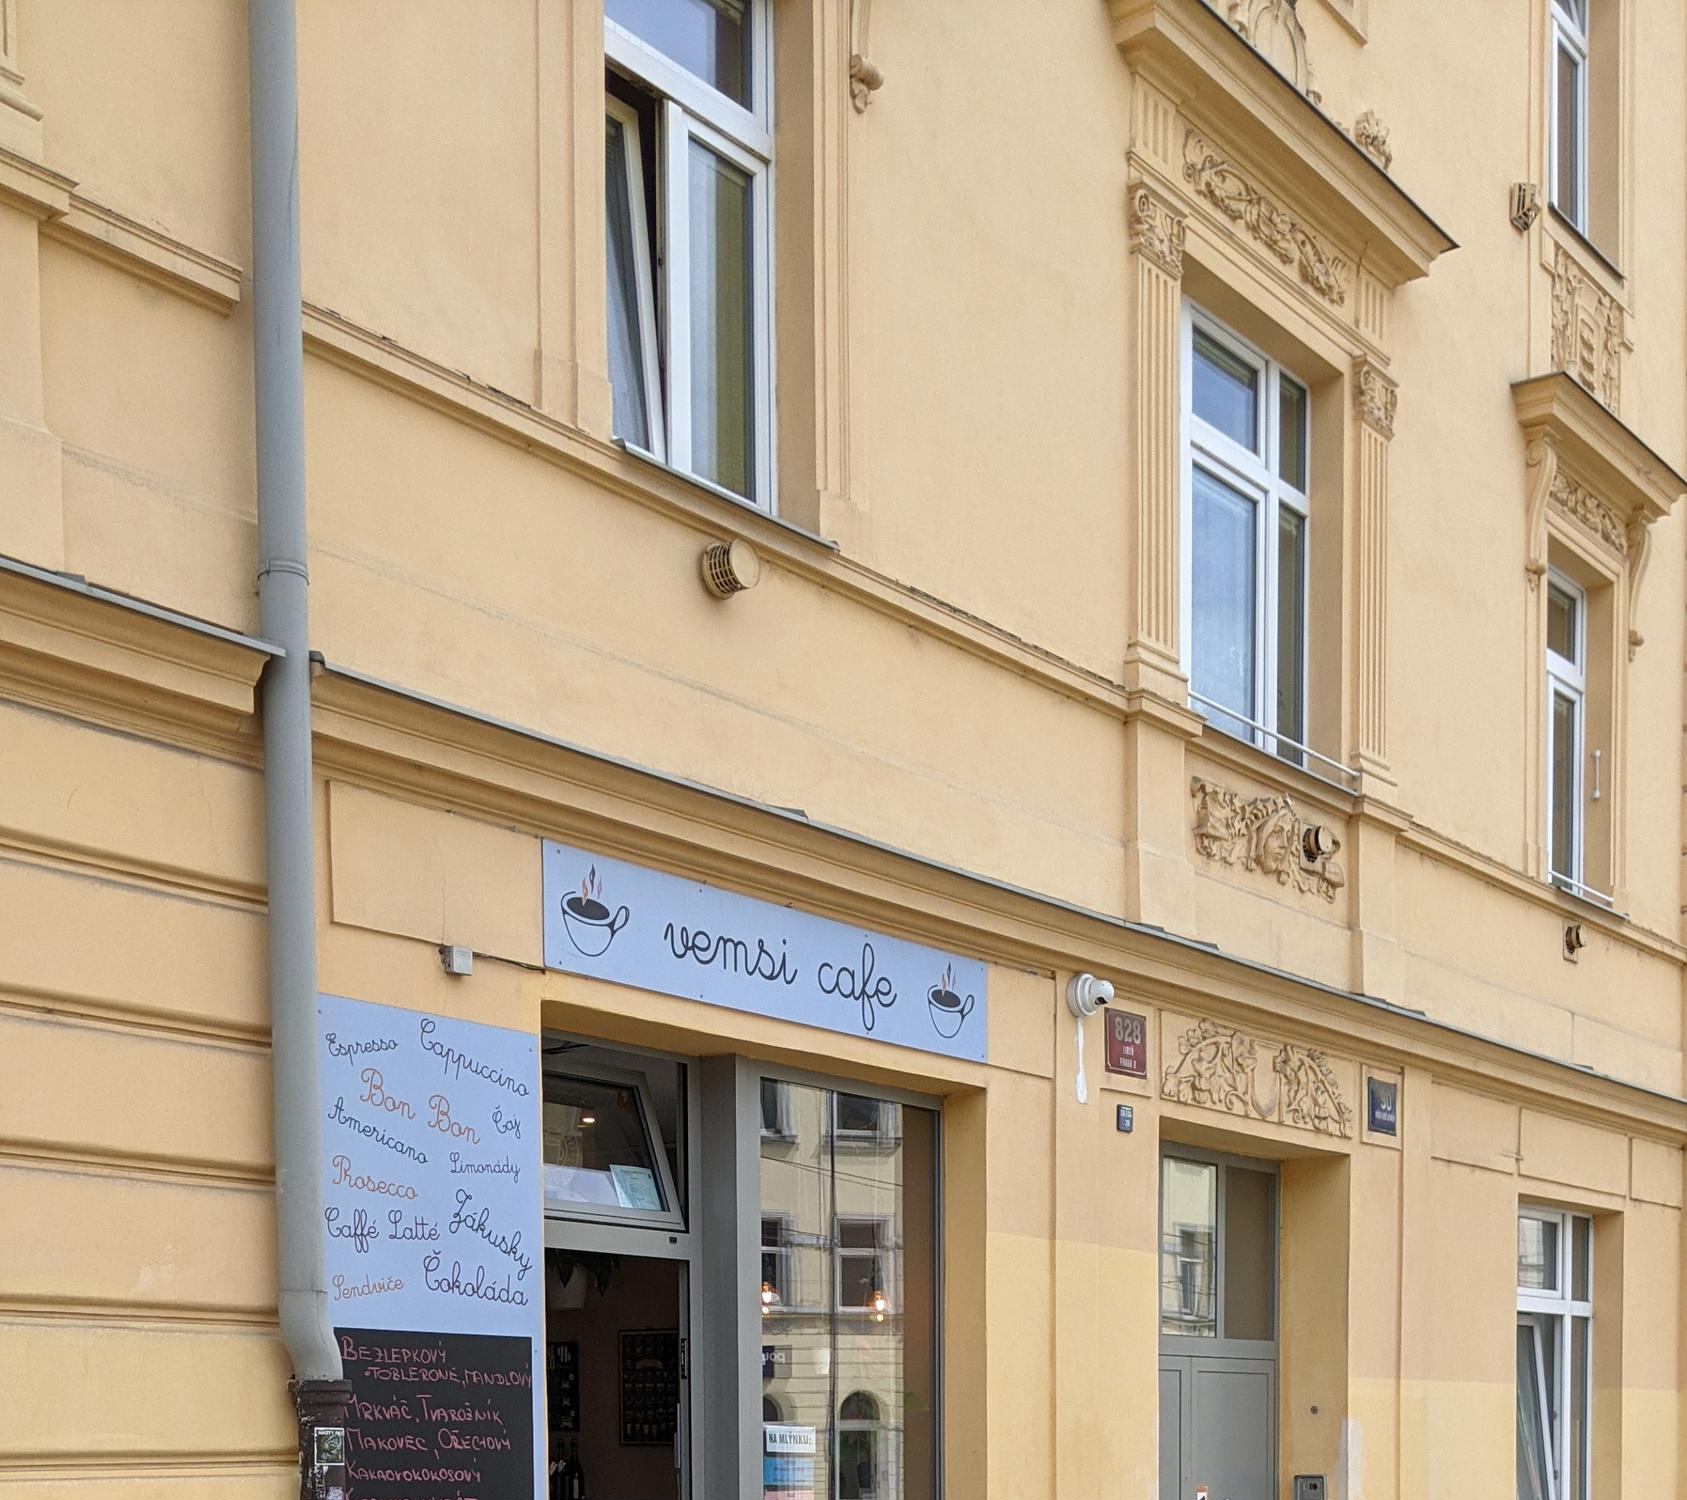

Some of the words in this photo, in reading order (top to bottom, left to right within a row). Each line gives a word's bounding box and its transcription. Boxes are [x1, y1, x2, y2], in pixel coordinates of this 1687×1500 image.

[664, 922, 798, 985] vemsi
[818, 942, 898, 1032] cafe
[326, 1033, 398, 1066] Espresso
[1116, 1016, 1140, 1044] 828
[420, 1018, 530, 1096] Cappuccino
[360, 1068, 415, 1120] Bon
[428, 1094, 480, 1144] Bon
[492, 1105, 520, 1139] Čaj
[328, 1096, 428, 1164] Americano
[332, 1155, 418, 1200] Prosecco
[450, 1152, 520, 1183] Limonády
[325, 1207, 379, 1253] Caffé
[388, 1210, 440, 1240] Latté
[449, 1188, 532, 1280] Zákusky
[333, 1273, 404, 1300] Sendviče
[424, 1250, 528, 1306] Čokoláda
[341, 1336, 446, 1364] BEZLEPKOVÝ
[768, 1433, 776, 1444] NA
[780, 1432, 812, 1445] MLÝNKU:
